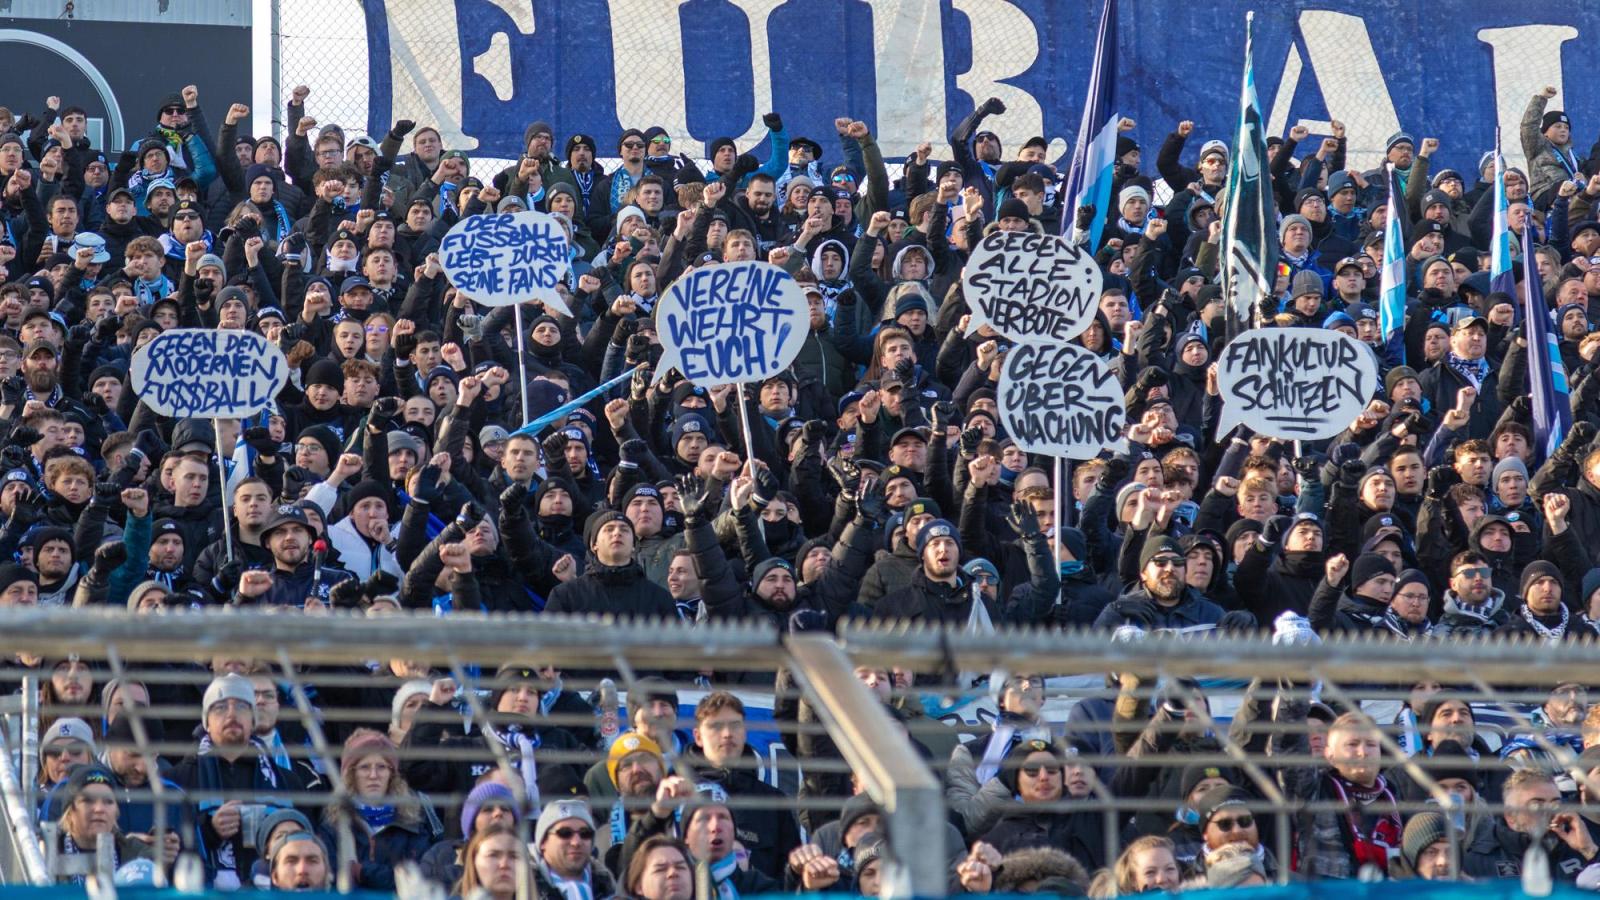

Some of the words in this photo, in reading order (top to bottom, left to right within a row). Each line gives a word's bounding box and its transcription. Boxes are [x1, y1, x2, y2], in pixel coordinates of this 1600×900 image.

[442, 222, 565, 251] FUSSBALL
[464, 213, 517, 233] DER
[445, 247, 503, 270] LEBT
[509, 244, 569, 268] DURCH
[983, 231, 1081, 261] GEGEN
[453, 267, 504, 295] SEINE
[508, 264, 558, 295] FANS
[672, 263, 791, 311] VEREINE
[969, 273, 1095, 318] STADION
[667, 303, 794, 347] WEHRT
[978, 296, 1076, 341] VERBOTE
[147, 332, 218, 359] GEGEN
[225, 334, 267, 356] DEN
[680, 323, 792, 380] EUCH!
[1226, 334, 1360, 373] FANKULTUR
[144, 354, 278, 381] MODERNEN
[1008, 344, 1113, 389] GEGEN
[1005, 381, 1114, 412] ÜBER-
[1231, 370, 1366, 416] SCHÜTZEN
[1008, 405, 1124, 446] WACHUNG
